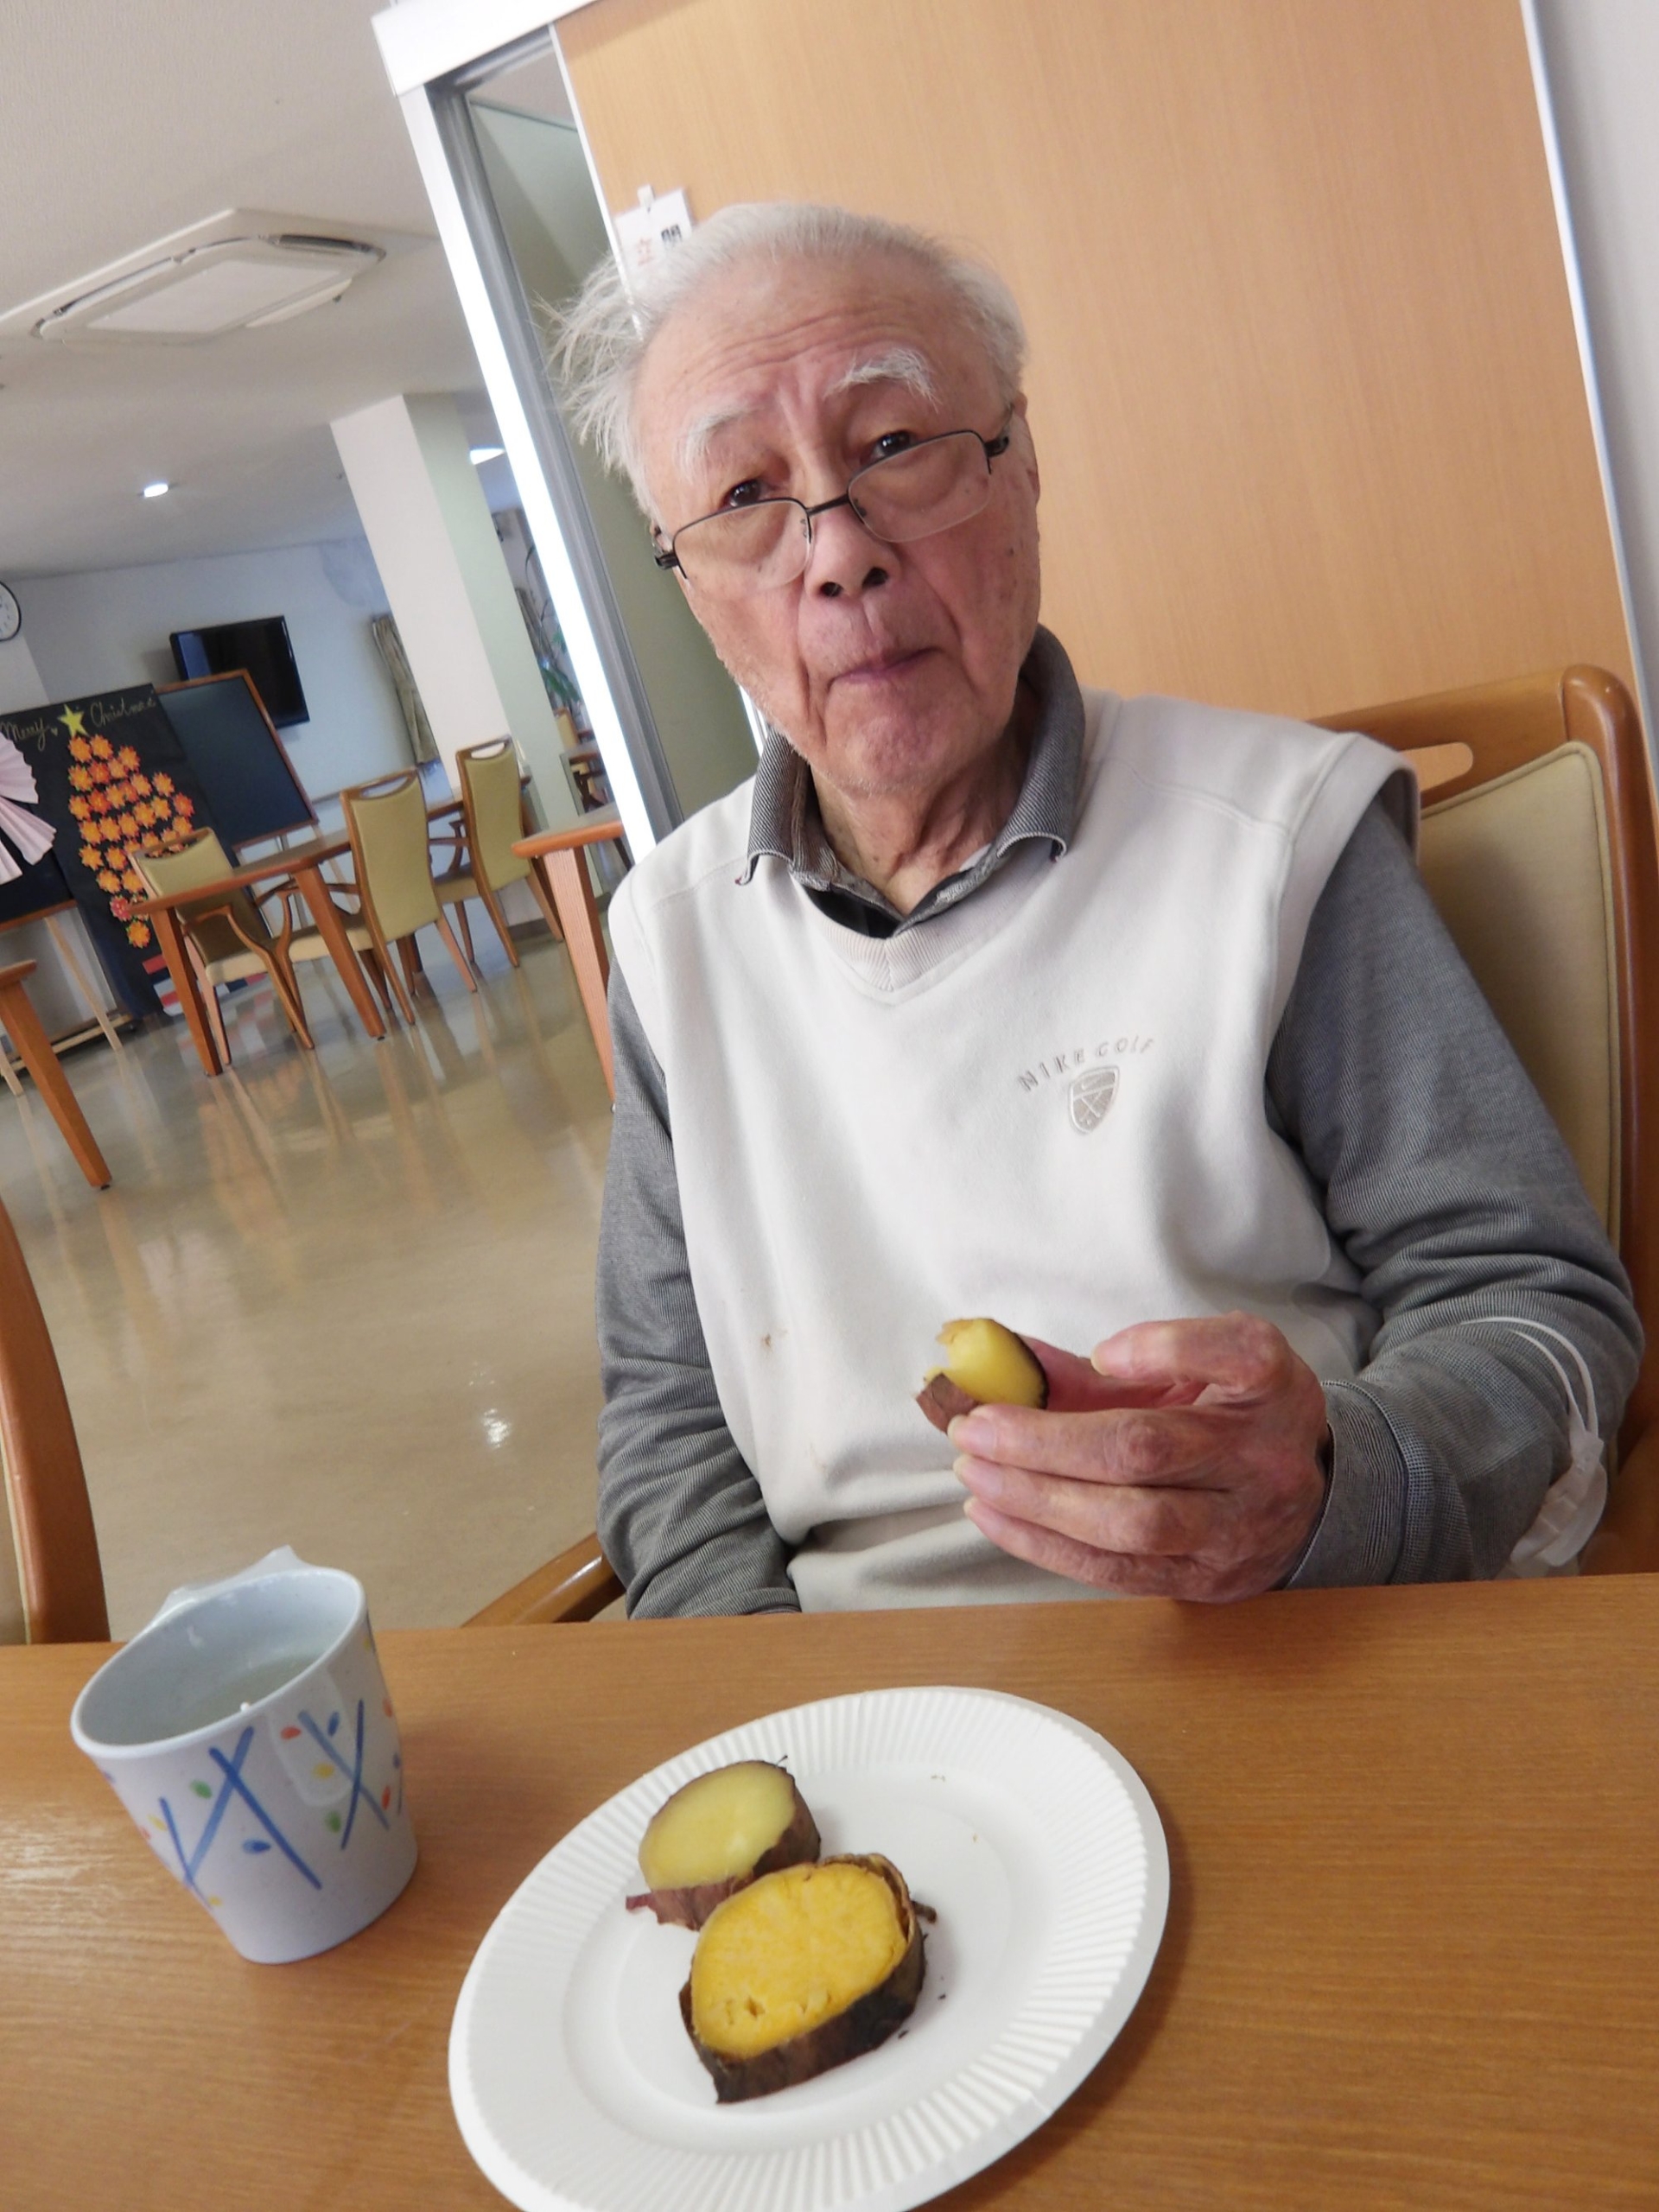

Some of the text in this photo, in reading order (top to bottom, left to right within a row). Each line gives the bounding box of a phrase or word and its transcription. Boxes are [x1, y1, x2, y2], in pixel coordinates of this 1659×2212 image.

[0, 696, 156, 752] Merry Christmas
[1018, 1048, 1084, 1092] NIKE
